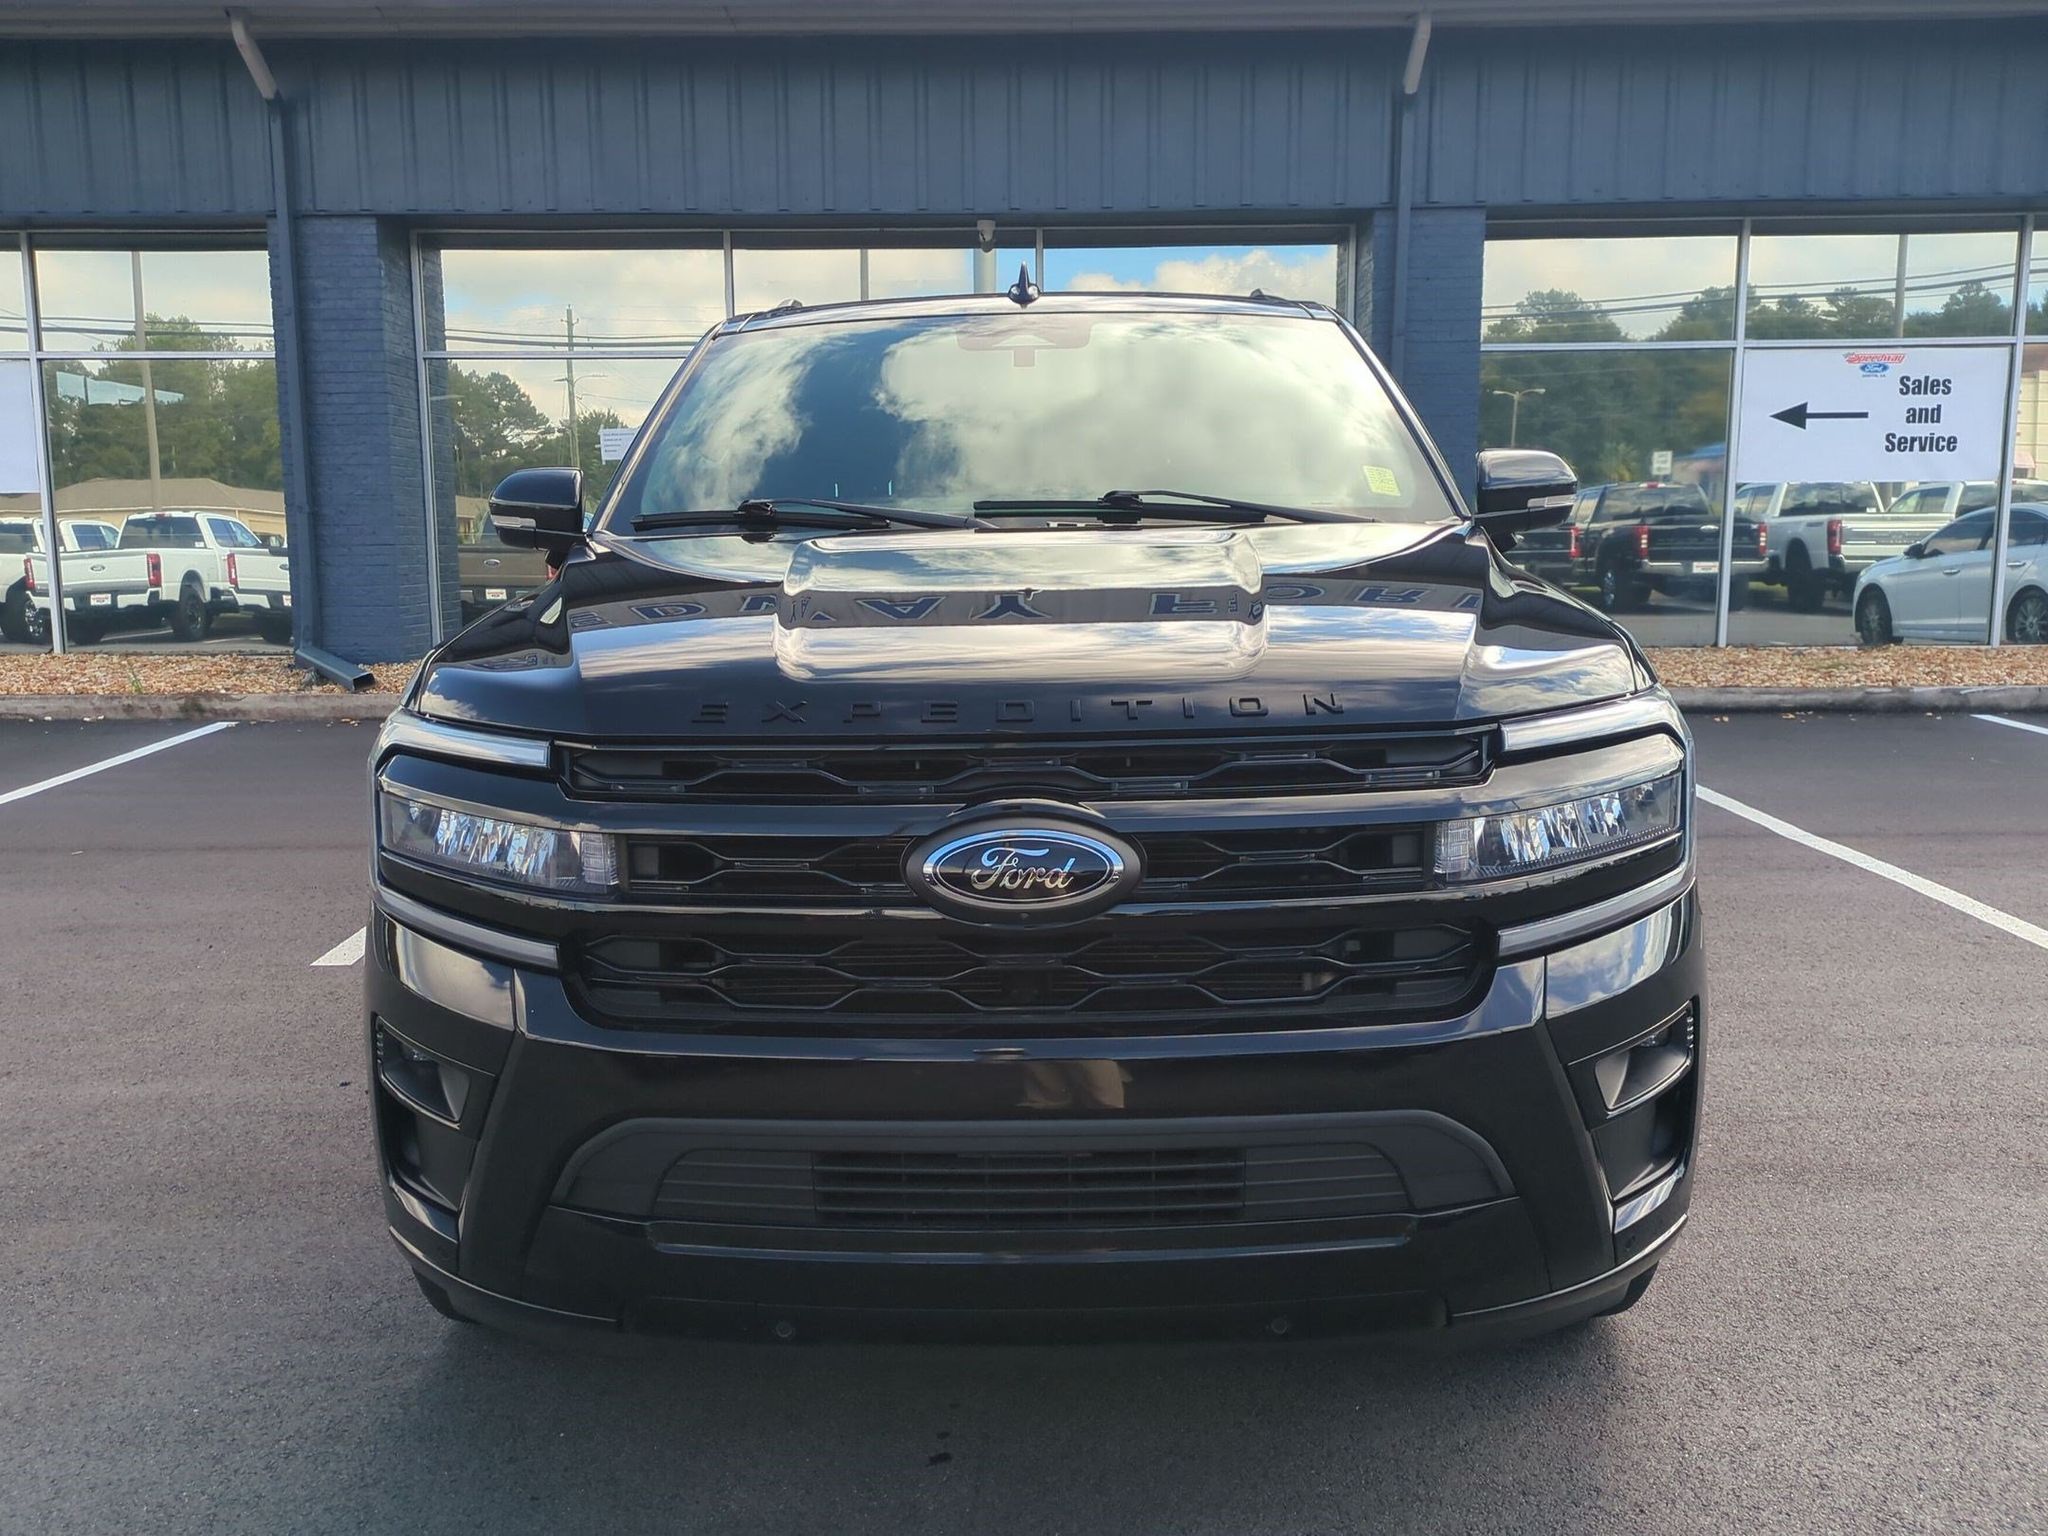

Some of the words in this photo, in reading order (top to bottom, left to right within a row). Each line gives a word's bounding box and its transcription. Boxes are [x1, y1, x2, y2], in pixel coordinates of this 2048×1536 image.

[1846, 352, 1906, 364] Speedway
[1899, 375, 1953, 396] Sales
[1905, 404, 1942, 424] and
[1885, 432, 1958, 453] Service
[691, 691, 1345, 724] EXPEDITION
[971, 846, 1075, 891] Ford
